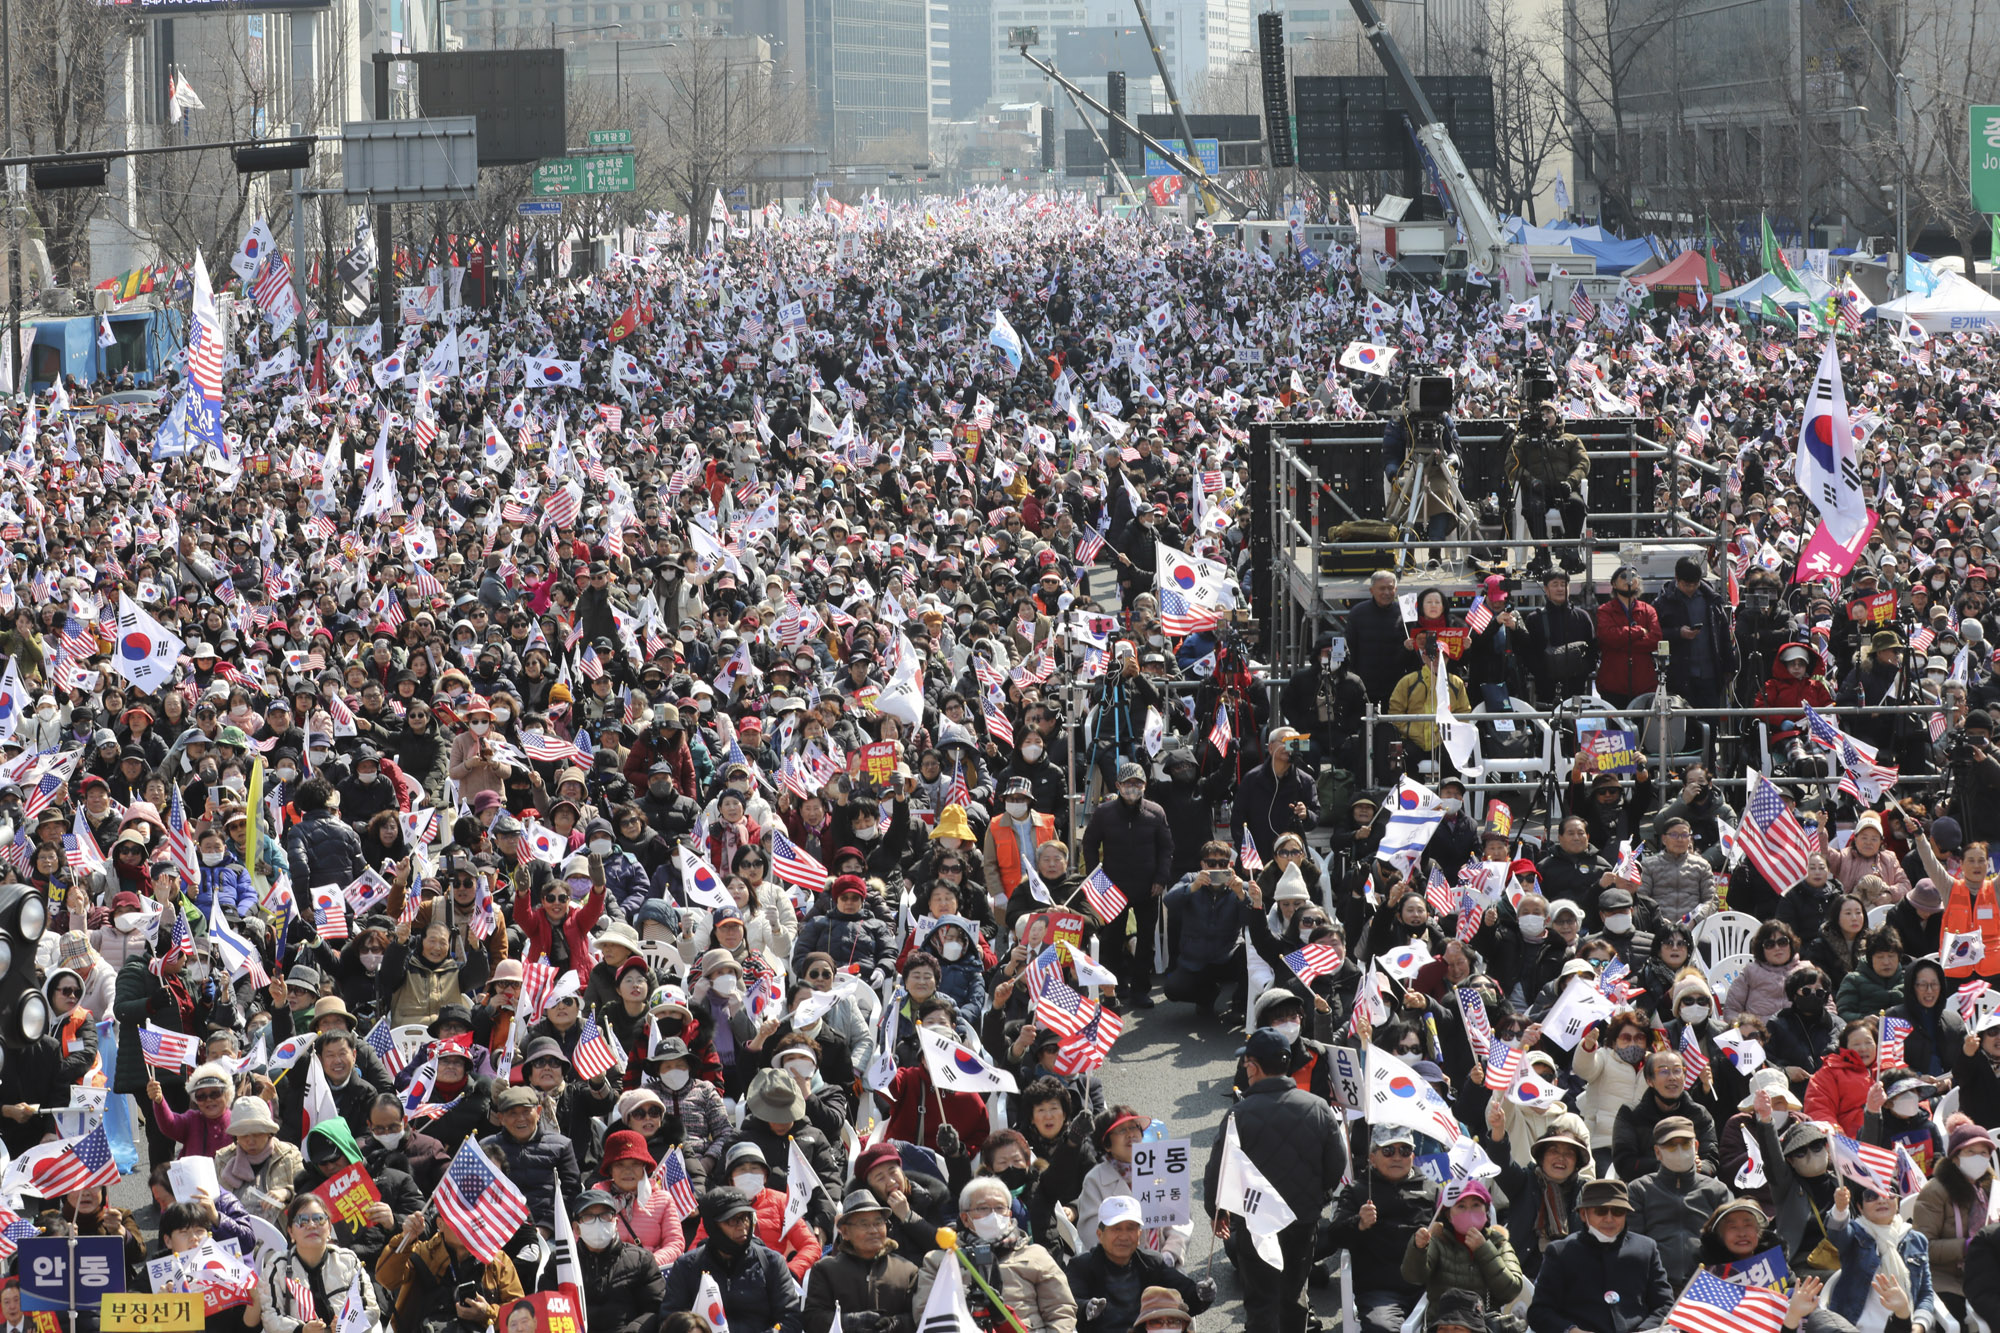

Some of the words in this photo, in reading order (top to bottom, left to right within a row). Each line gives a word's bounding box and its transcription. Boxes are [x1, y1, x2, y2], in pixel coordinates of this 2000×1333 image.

[594, 132, 626, 142] 청계광장
[596, 159, 623, 169] 숭례문
[1982, 153, 2000, 170] Jo
[539, 164, 573, 176] 청계1가
[598, 176, 615, 186] 시청
[1238, 350, 1261, 361] 전북
[867, 745, 893, 756] 4대4
[1594, 735, 1626, 753] 국회
[868, 756, 895, 771] 탄핵
[1597, 750, 1635, 771] 해제!
[1341, 1079, 1358, 1106] 창
[329, 1169, 361, 1198] 4대4
[334, 1183, 373, 1217] 탄핵
[1140, 1187, 1181, 1203] 서구동
[1145, 1213, 1176, 1224] 자유마을
[111, 1301, 191, 1324] 부정선거
